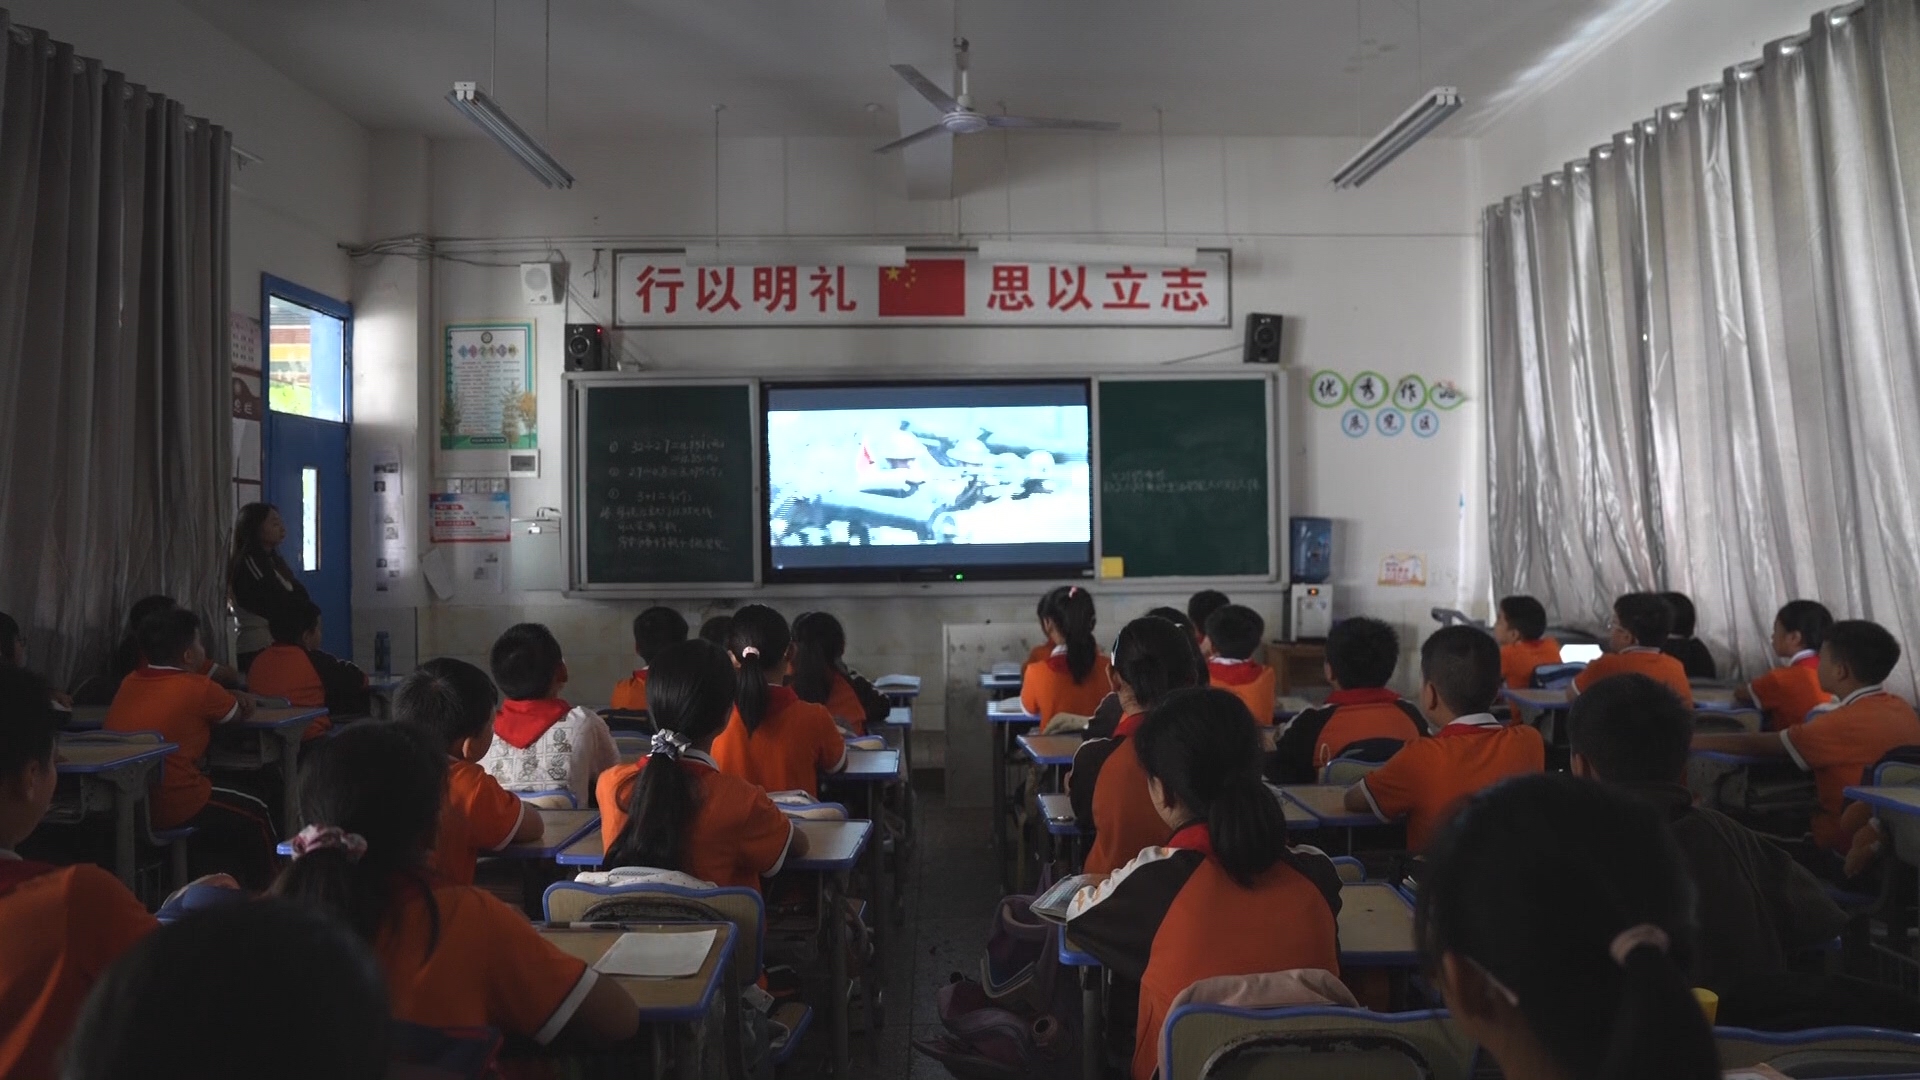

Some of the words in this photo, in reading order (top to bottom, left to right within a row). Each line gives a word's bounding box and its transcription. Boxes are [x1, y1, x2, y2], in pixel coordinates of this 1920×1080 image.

[636, 265, 857, 314] 行以明礼
[987, 265, 1209, 312] 思以立志
